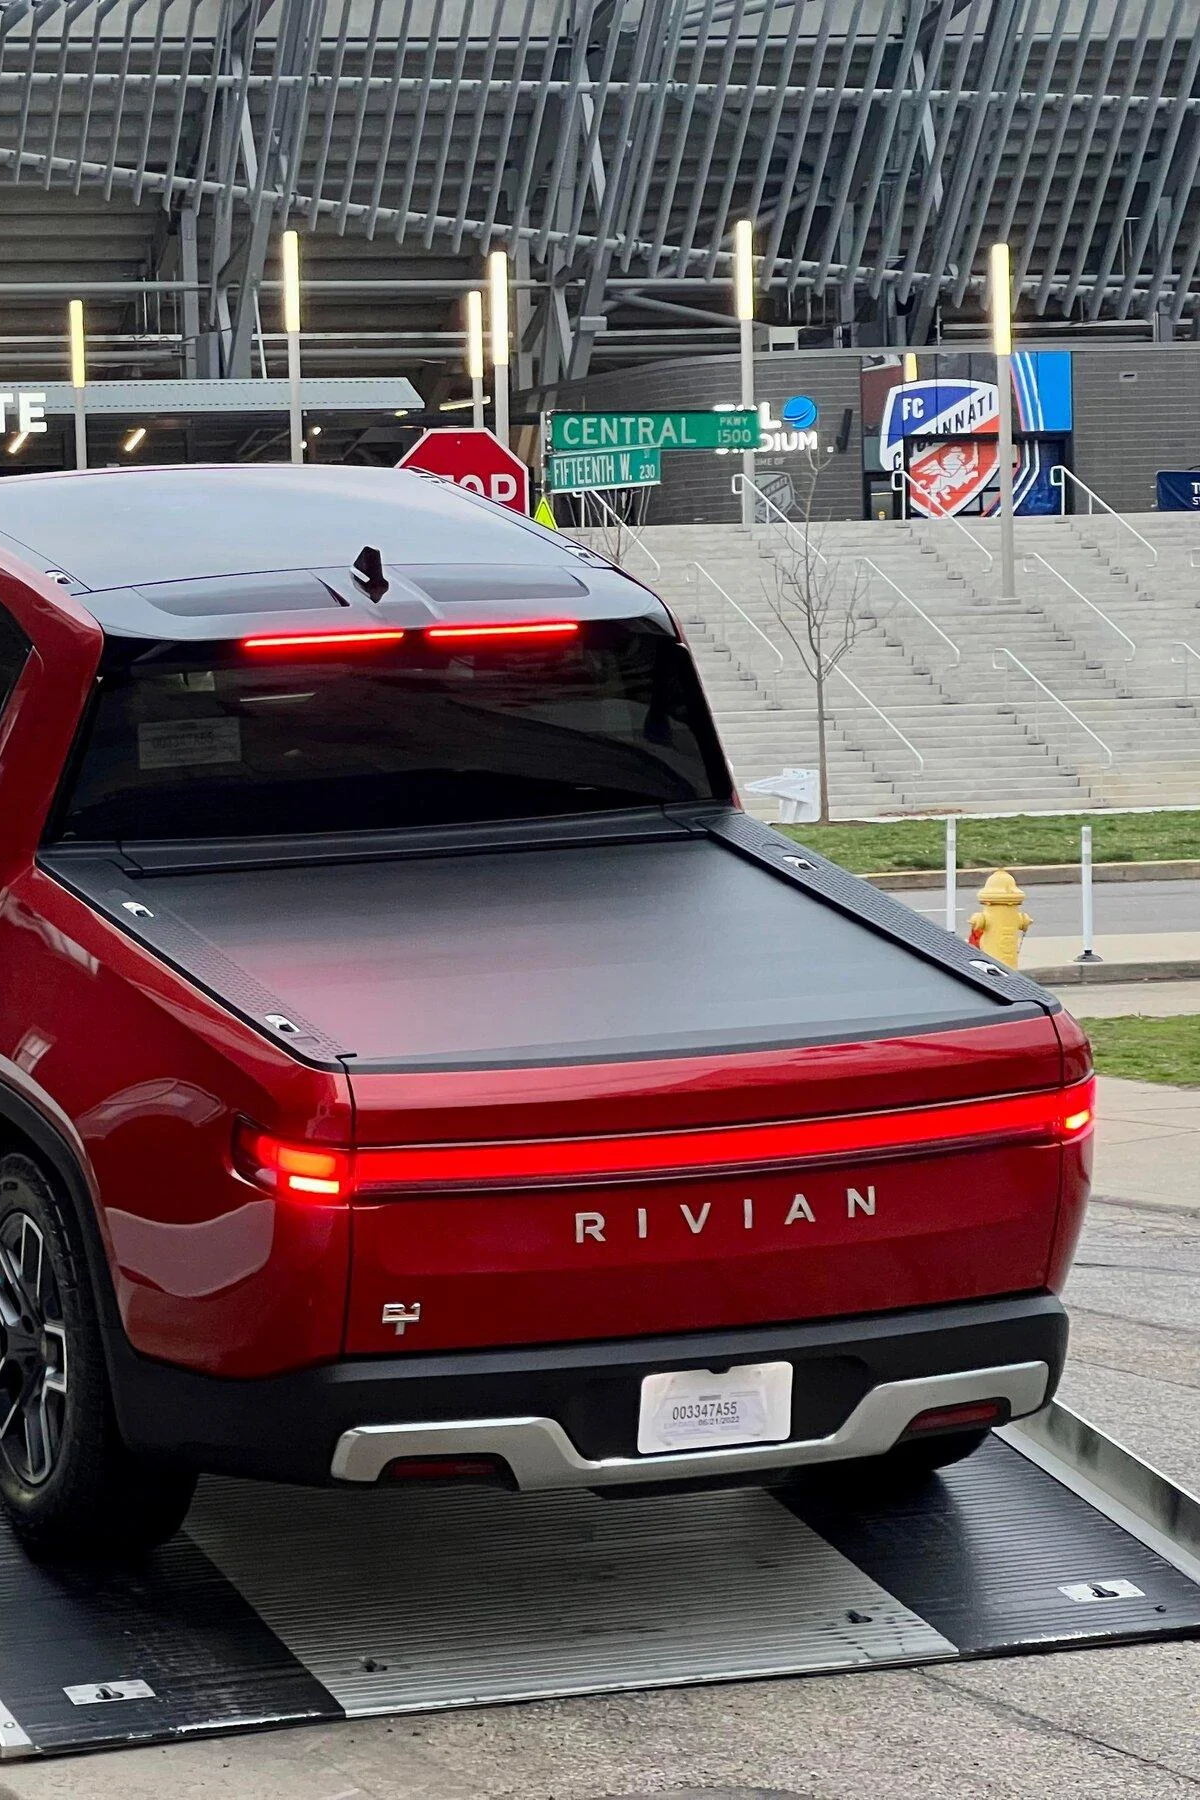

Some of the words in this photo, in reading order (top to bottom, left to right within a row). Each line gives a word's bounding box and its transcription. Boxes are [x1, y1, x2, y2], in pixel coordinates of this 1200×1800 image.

[902, 397, 924, 421] FC
[563, 417, 697, 446] CENTRAL
[719, 416, 749, 427] PKWY
[717, 429, 751, 443] 1500
[553, 455, 615, 486] FIFTEENTH
[639, 464, 656, 480] 230
[574, 1185, 877, 1244] RIVIAN
[672, 1401, 738, 1421] 003347A55
